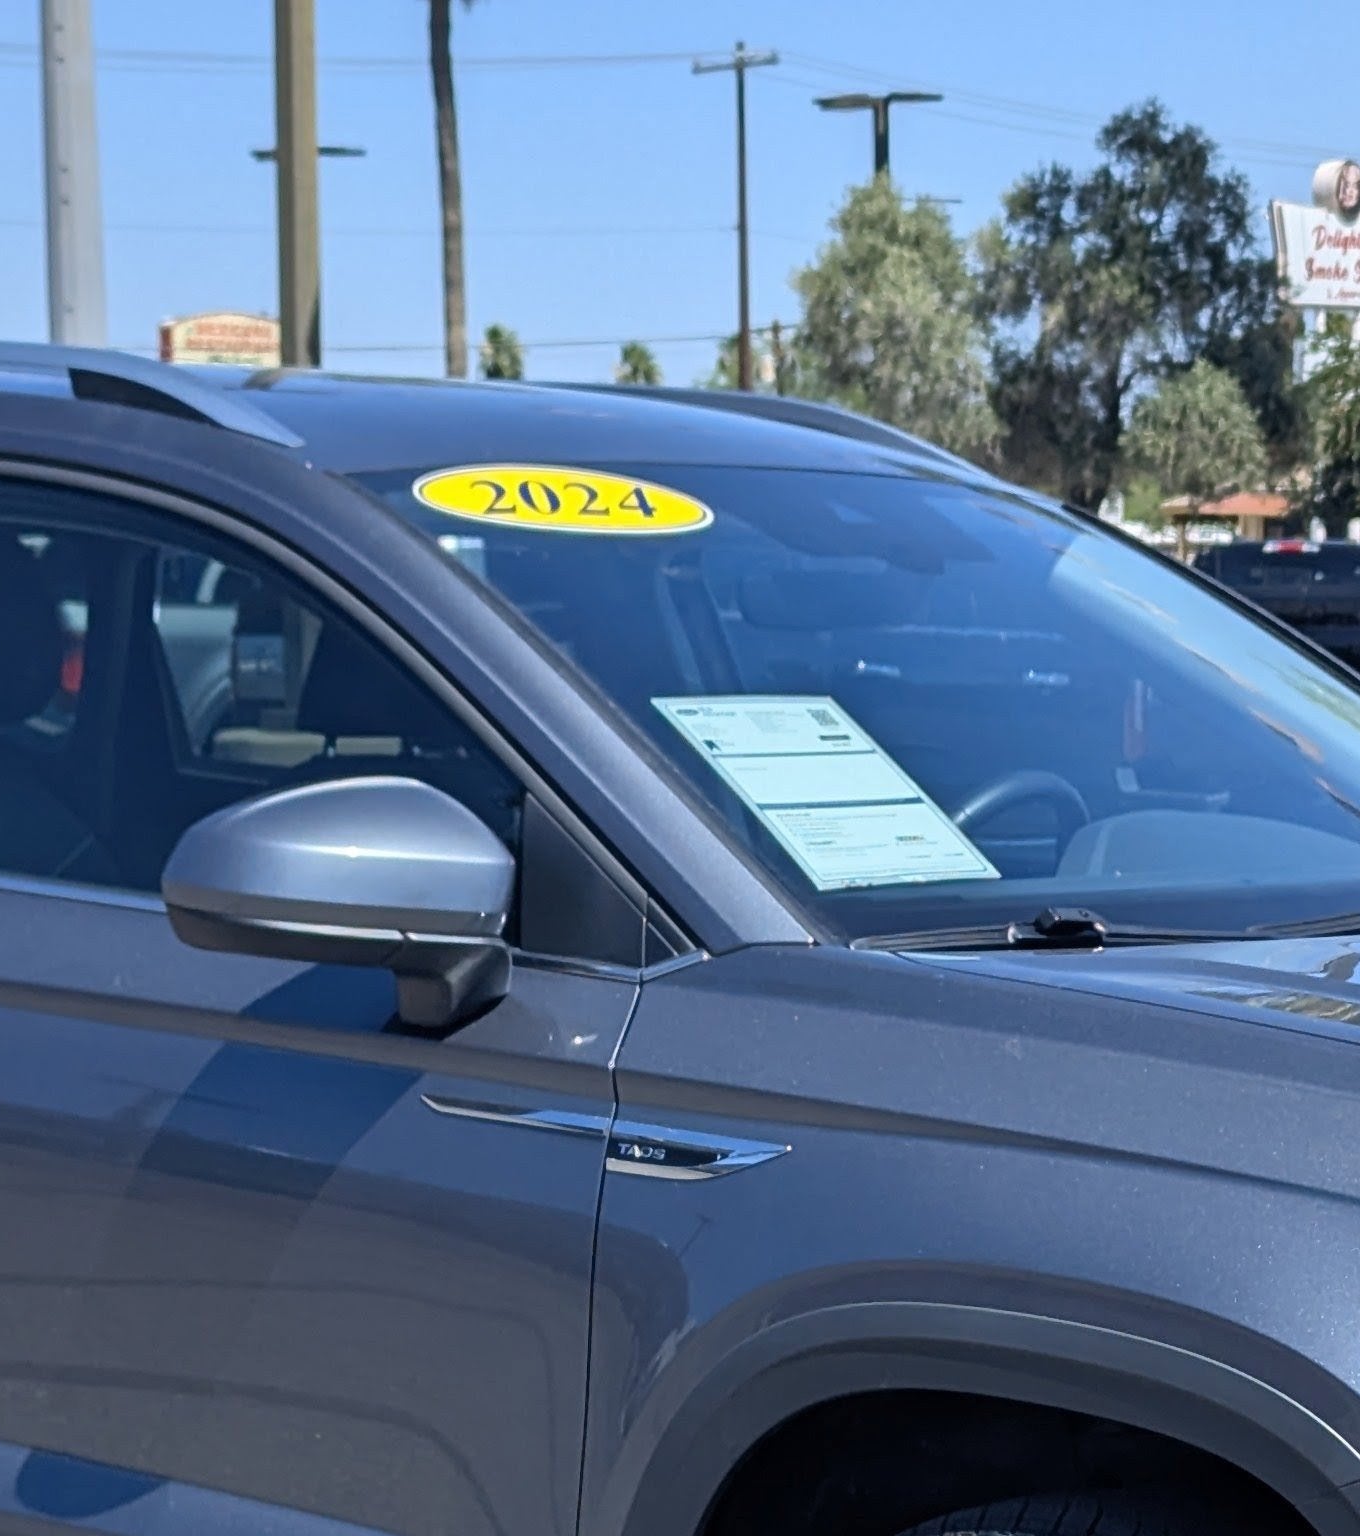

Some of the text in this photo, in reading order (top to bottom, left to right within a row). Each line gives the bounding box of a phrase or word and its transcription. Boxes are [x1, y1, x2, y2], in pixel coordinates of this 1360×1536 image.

[1304, 257, 1348, 281] Smoke
[469, 480, 657, 518] 2024
[618, 1142, 666, 1160] TAOS
